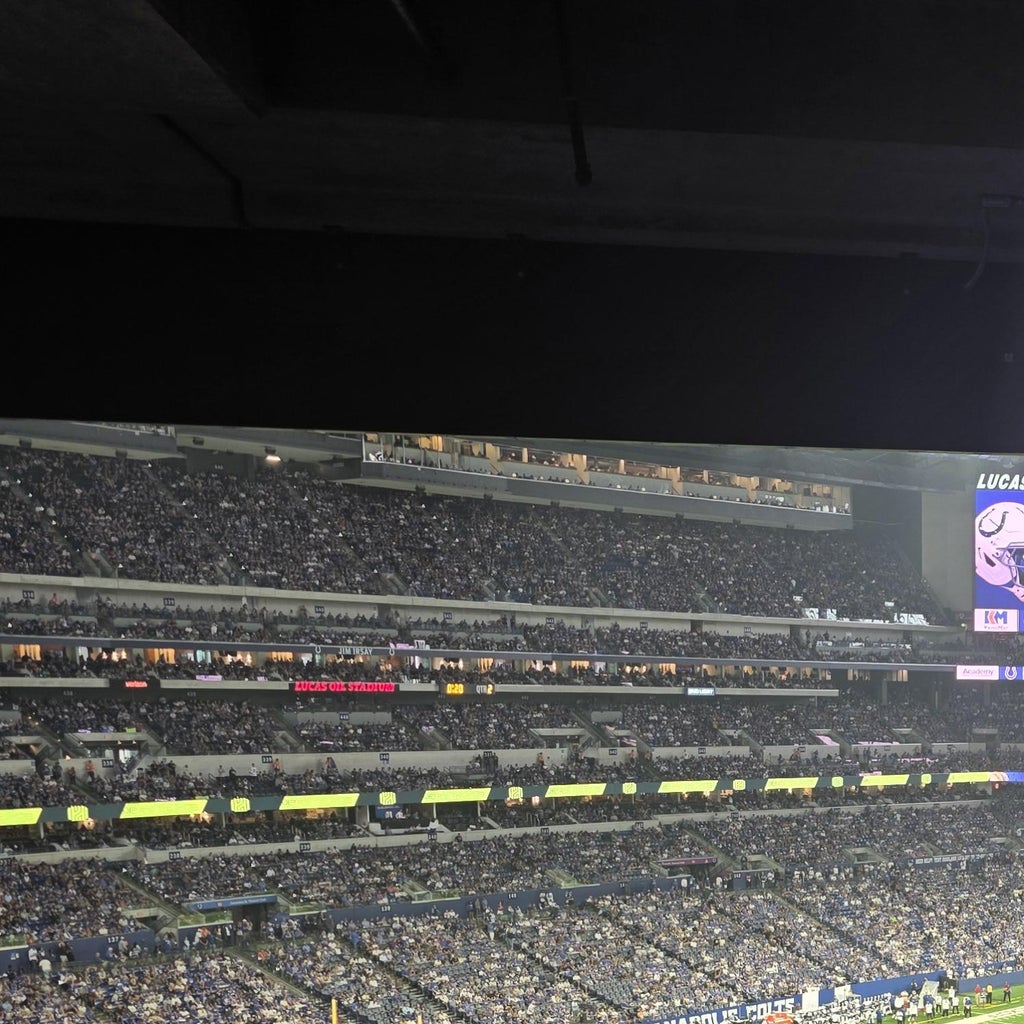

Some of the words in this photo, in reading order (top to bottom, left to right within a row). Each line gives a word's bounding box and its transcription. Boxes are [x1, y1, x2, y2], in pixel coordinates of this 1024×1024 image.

[963, 668, 994, 676] Academy
[295, 682, 327, 692] LUCAS
[329, 682, 346, 692] OIL
[348, 683, 394, 692] STADIUM
[745, 998, 795, 1022] COLTS
